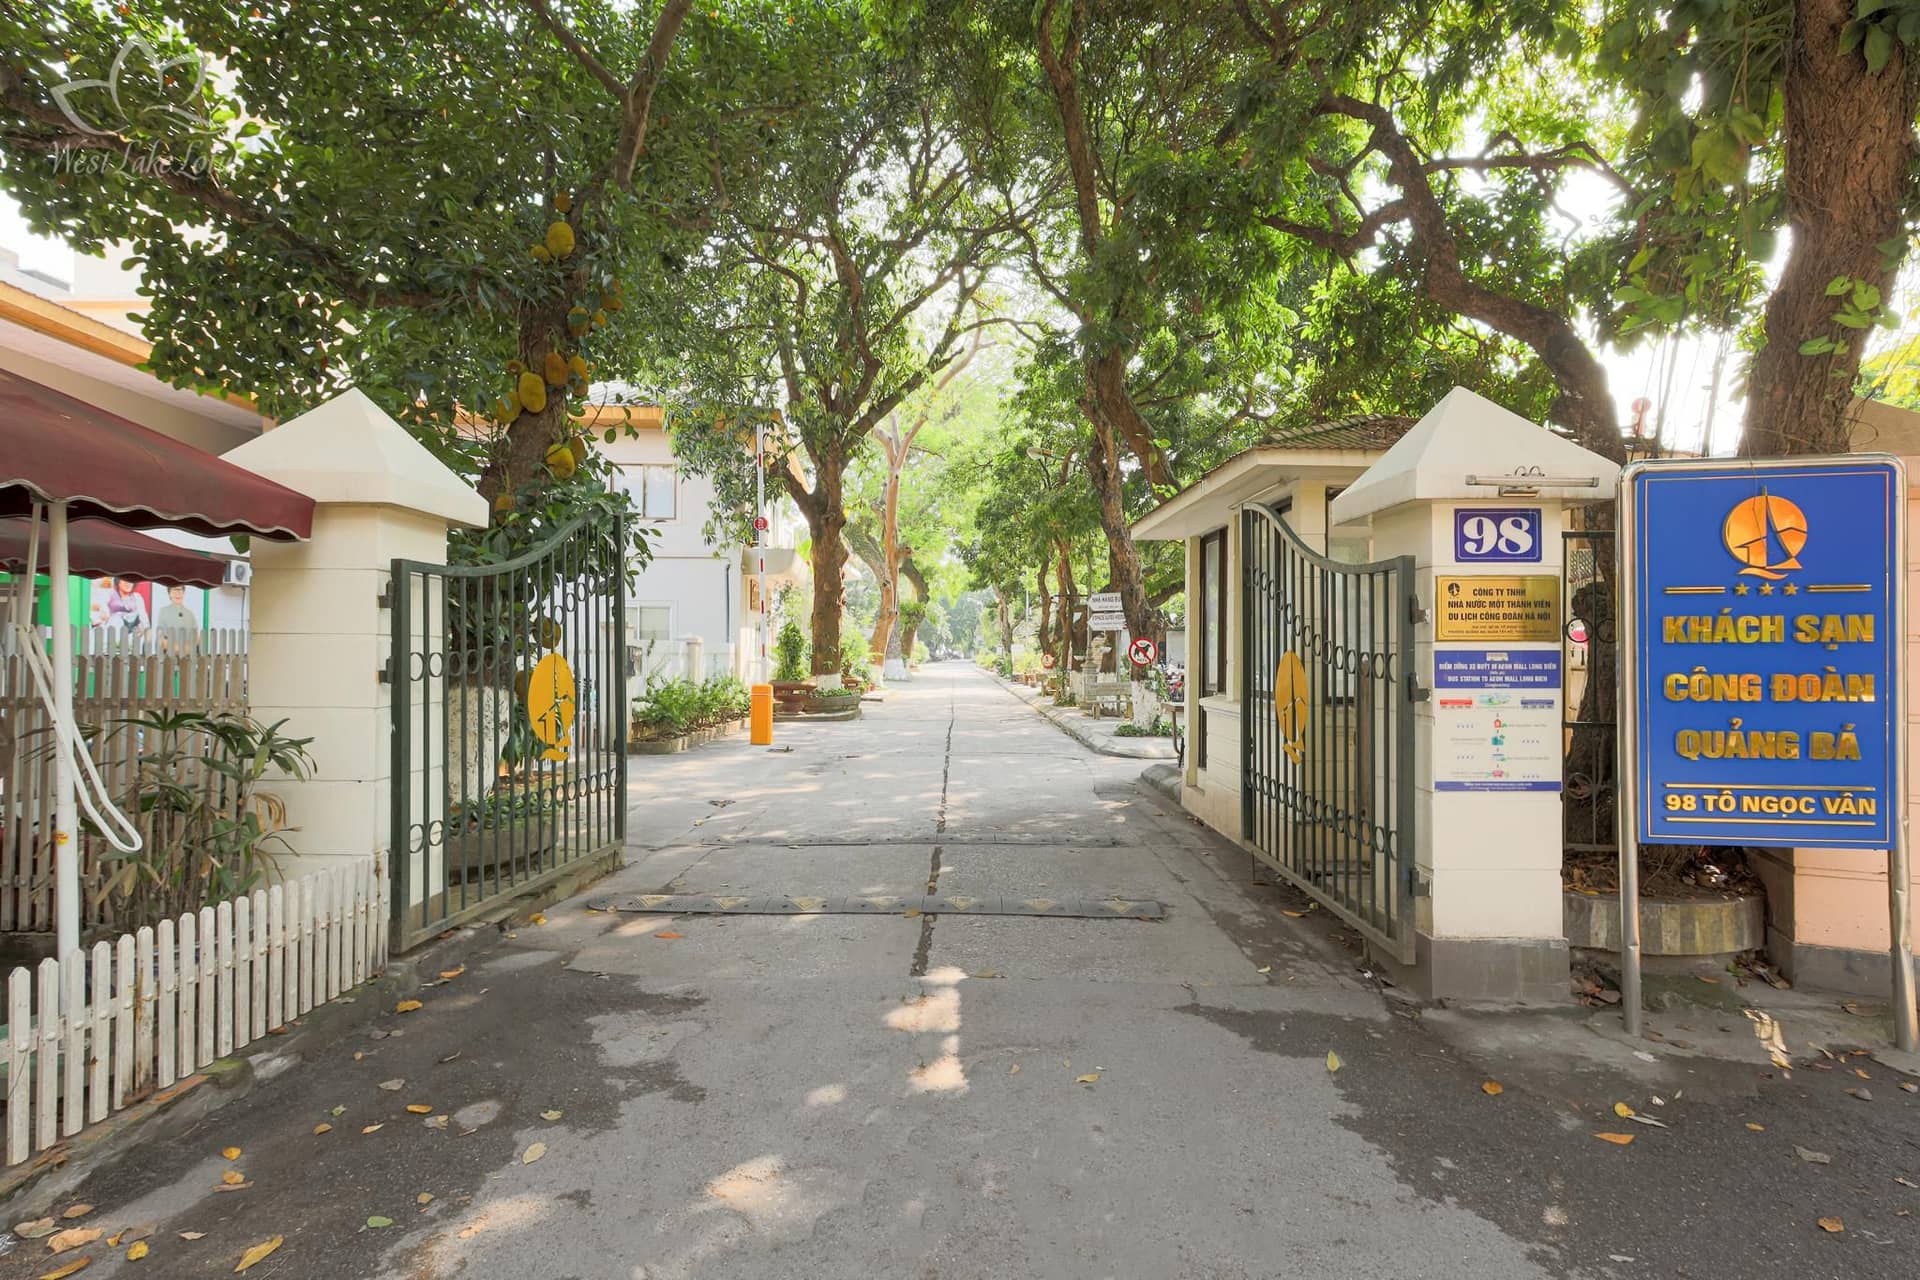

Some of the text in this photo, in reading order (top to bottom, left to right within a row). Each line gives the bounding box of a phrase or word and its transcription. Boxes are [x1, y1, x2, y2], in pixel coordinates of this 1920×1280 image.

[1463, 516, 1533, 555] 98
[1448, 598, 1551, 609] NHÀ NƯỚC MỘT THÀNH VIÊN
[1472, 587, 1527, 597] CÔNG TY TNHH
[1448, 612, 1459, 621] DU
[1461, 612, 1478, 622] LỊCH
[1479, 611, 1501, 621] CÔNG
[1662, 607, 1876, 651] KHÁCH SẠN
[1663, 666, 1876, 703] CÔNG ĐOÀN
[1675, 717, 1862, 761] QUẢNG BÁ
[1665, 790, 1877, 818] 98 TÔ NGỌC VÂN
